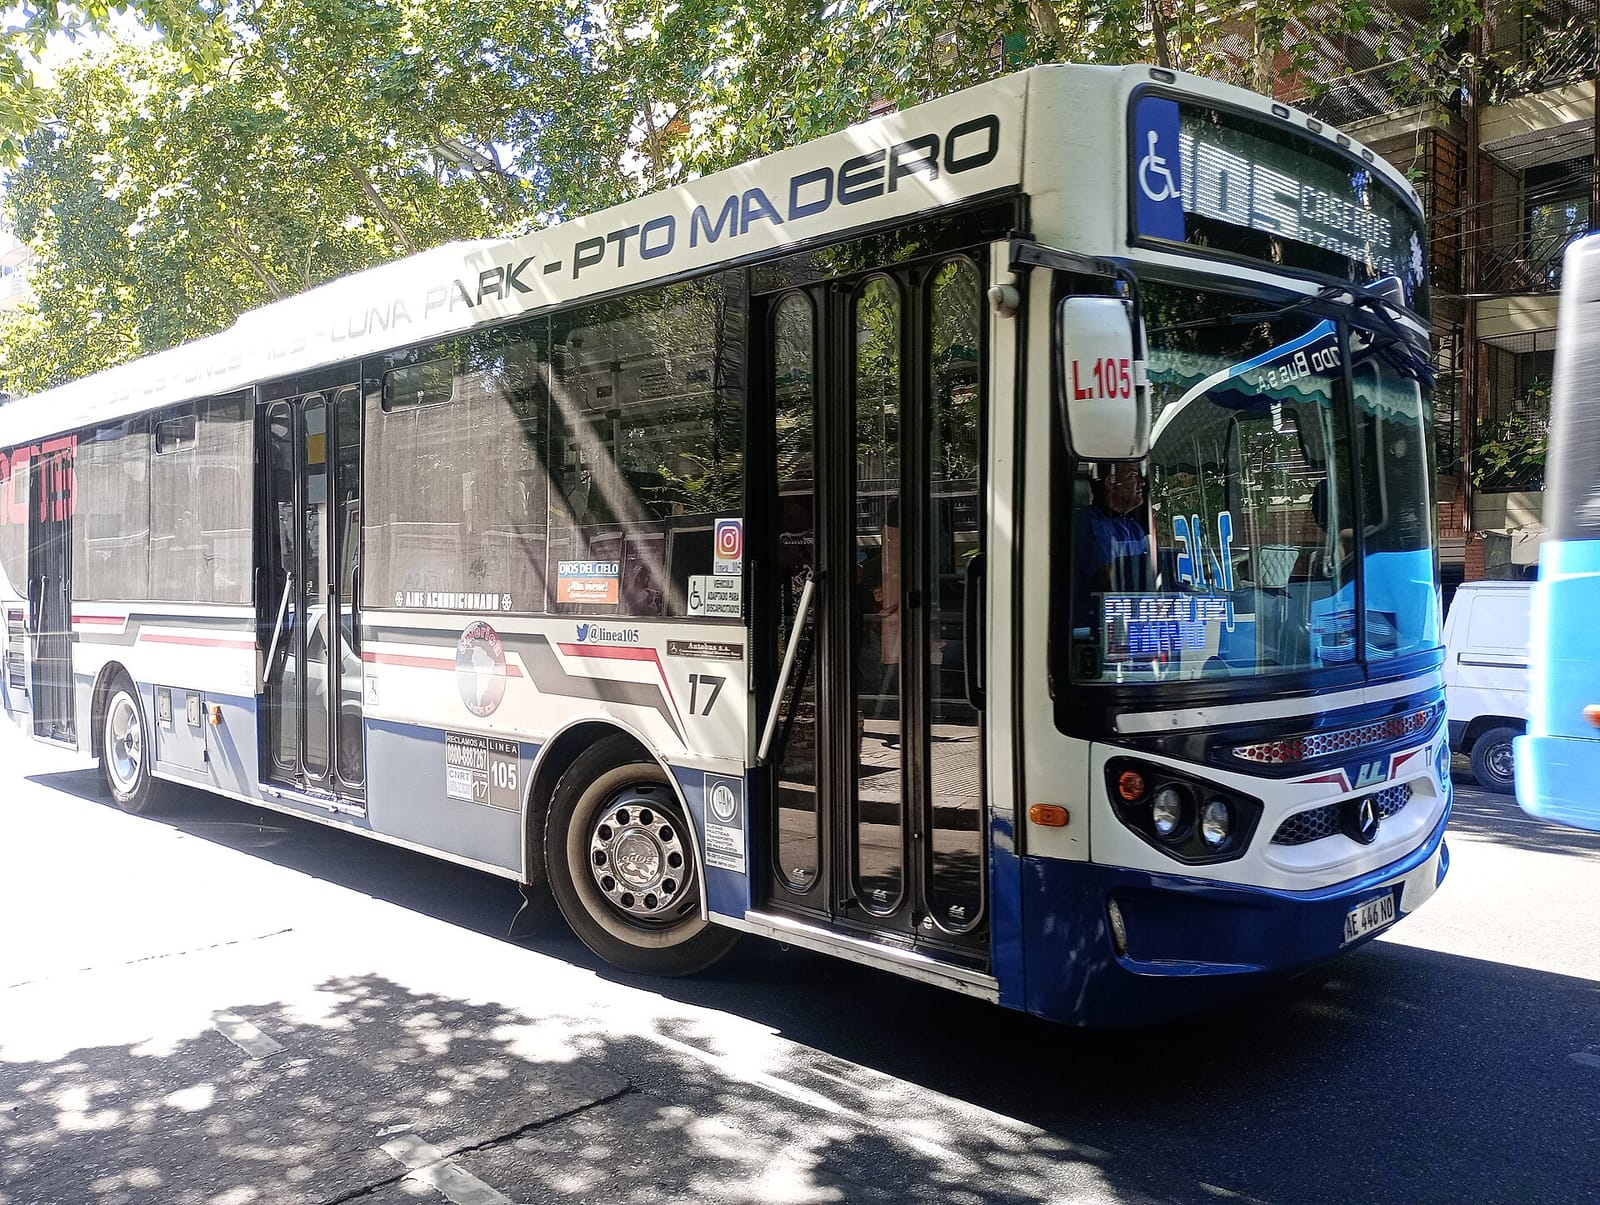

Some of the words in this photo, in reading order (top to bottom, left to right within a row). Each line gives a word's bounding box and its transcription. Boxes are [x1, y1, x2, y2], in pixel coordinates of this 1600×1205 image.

[1178, 132, 1300, 241] 105
[330, 298, 413, 343] LUNA
[424, 257, 535, 314] PARK
[572, 214, 676, 280] PTO
[689, 113, 1000, 248] MADERO
[1072, 357, 1131, 400] L.105
[559, 563, 579, 576] OJOS
[580, 563, 595, 574] DEL
[596, 563, 619, 575] CIELO
[405, 591, 425, 607] AIRE
[426, 592, 499, 611] ACONDICIONADO
[588, 623, 640, 644] @linea105
[688, 673, 727, 716] 17
[447, 735, 478, 748] RECLAMOS
[479, 740, 487, 749] AL
[489, 741, 517, 754] LINEA
[1424, 744, 1433, 768] 17
[448, 769, 471, 781] CNRT
[491, 760, 517, 791] 105
[472, 780, 488, 798] 17
[1346, 912, 1359, 940] AE
[1361, 903, 1379, 931] 446
[1380, 896, 1393, 922] NO
